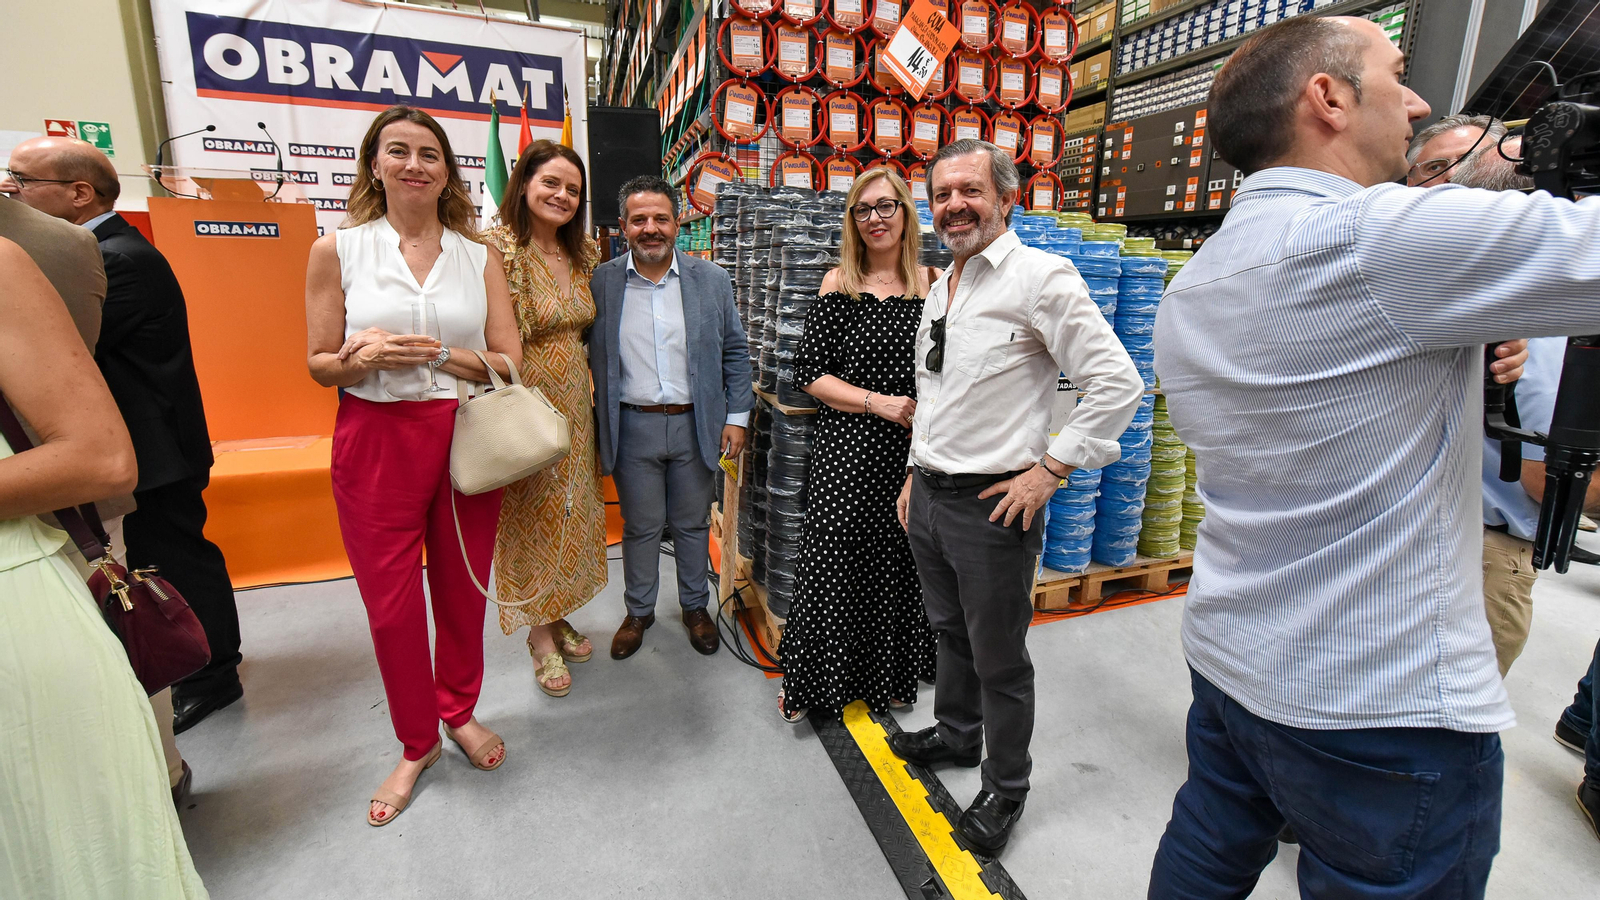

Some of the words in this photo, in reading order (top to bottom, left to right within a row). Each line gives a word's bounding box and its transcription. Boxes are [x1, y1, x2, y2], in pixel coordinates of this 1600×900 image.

[203, 32, 553, 110] OBRAMAT
[204, 139, 275, 153] OBRAMAT
[290, 145, 354, 158] OBRAMAT
[197, 223, 277, 236] OBRAMAT
